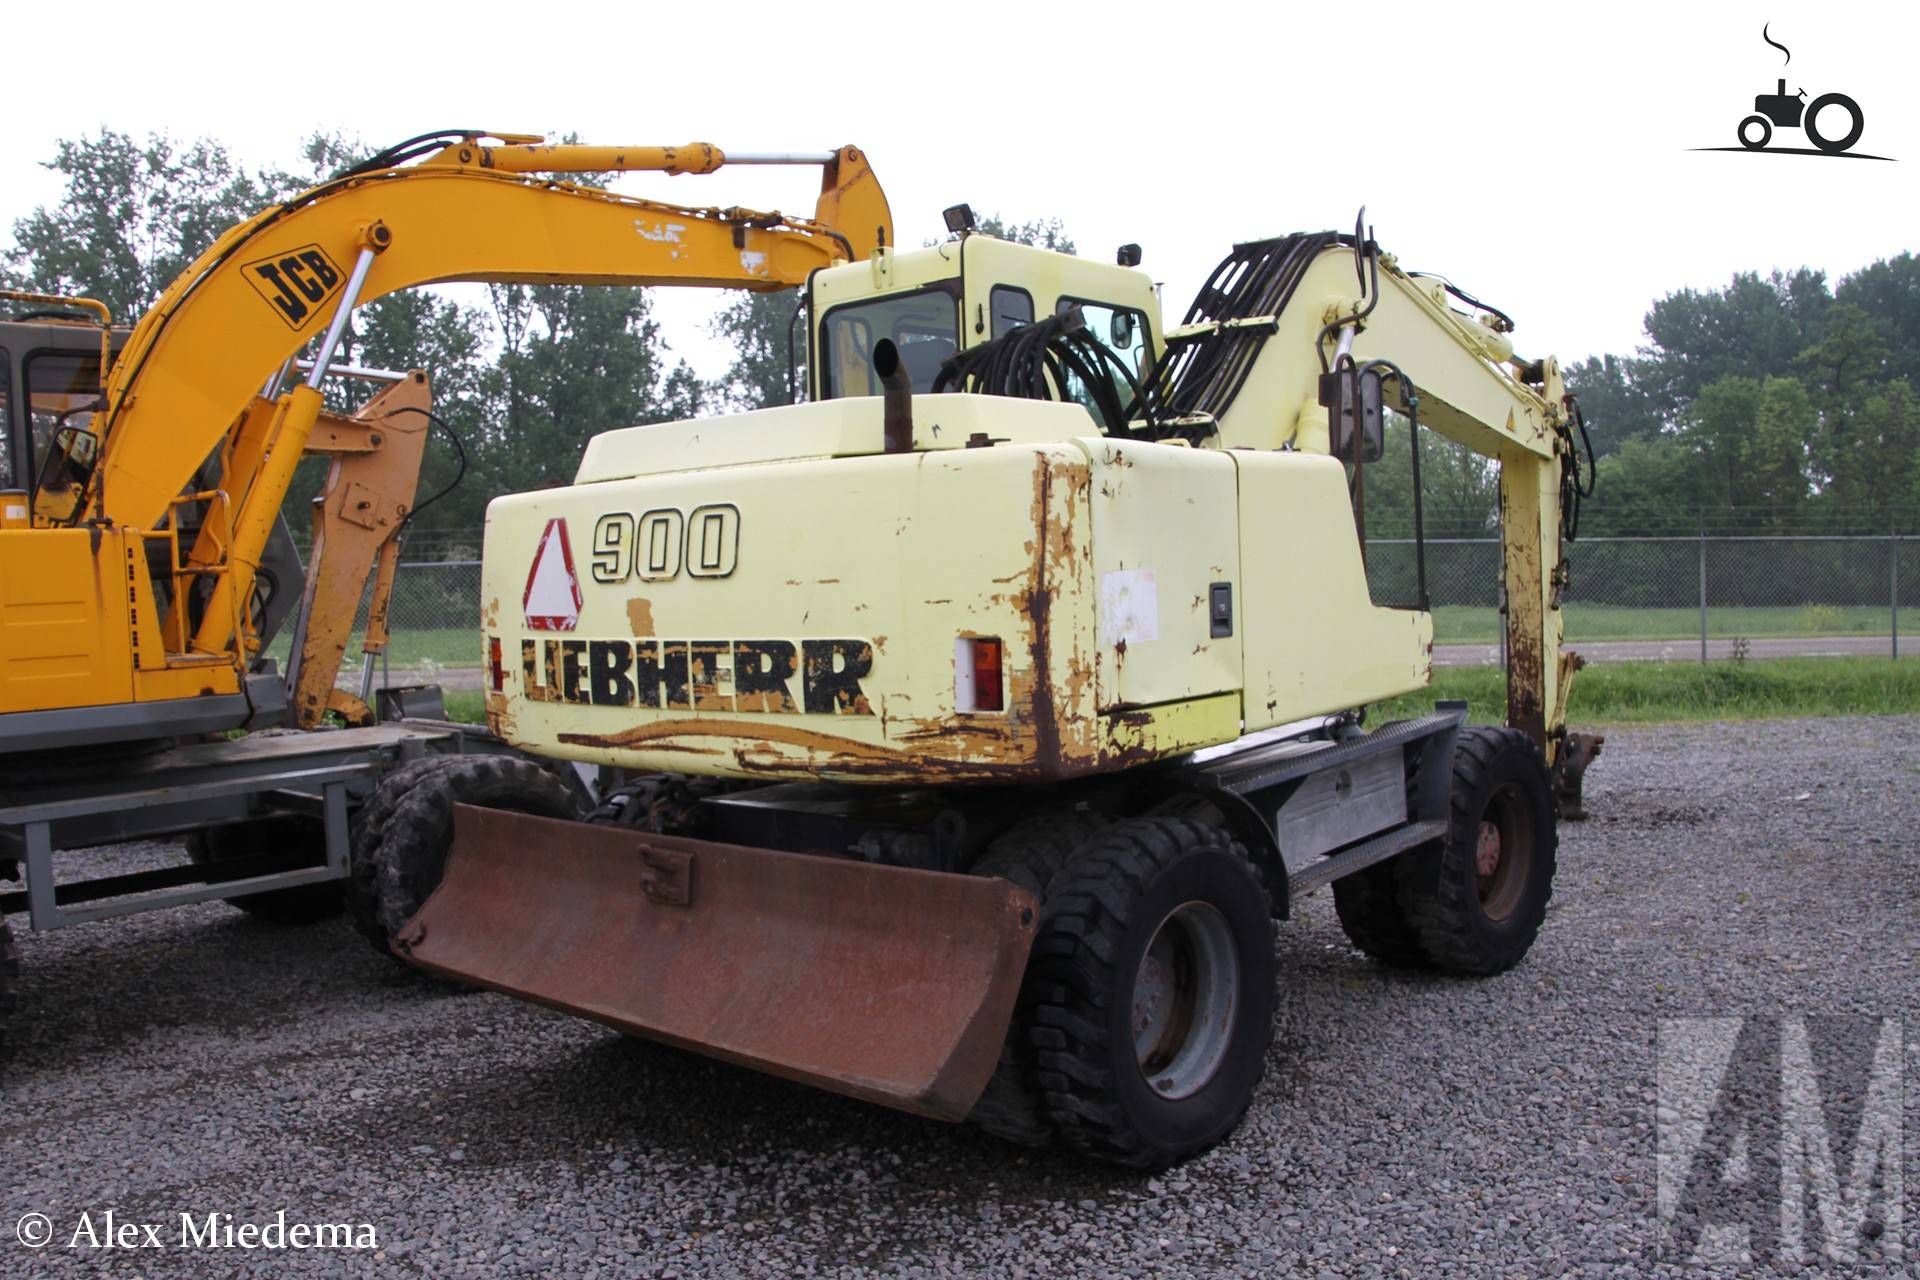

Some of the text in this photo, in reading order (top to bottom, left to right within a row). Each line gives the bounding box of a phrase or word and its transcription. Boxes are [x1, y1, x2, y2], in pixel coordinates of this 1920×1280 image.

[255, 250, 338, 324] JCB
[592, 503, 741, 584] 900
[521, 639, 877, 716] LIEBHERR
